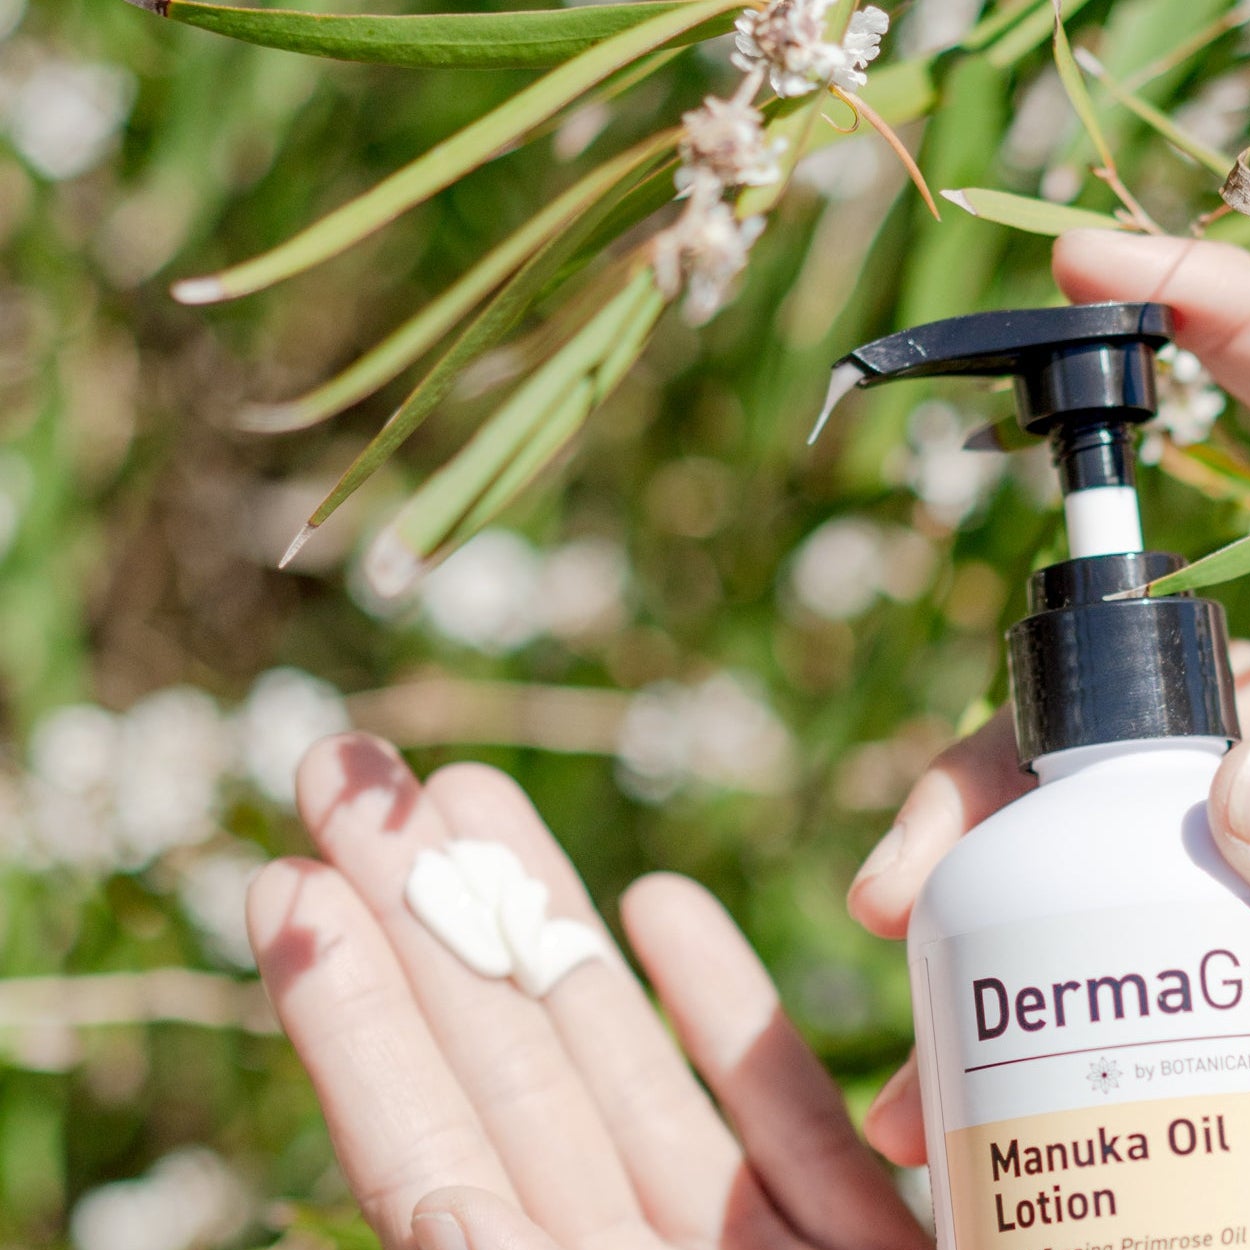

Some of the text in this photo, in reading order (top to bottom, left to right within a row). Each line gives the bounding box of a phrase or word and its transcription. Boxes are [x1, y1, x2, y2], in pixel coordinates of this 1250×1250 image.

[1135, 1064, 1154, 1080] by
[990, 1115, 1230, 1182] Manuka Oil
[995, 1185, 1117, 1233] Lotion
[1221, 1227, 1247, 1245] Oil
